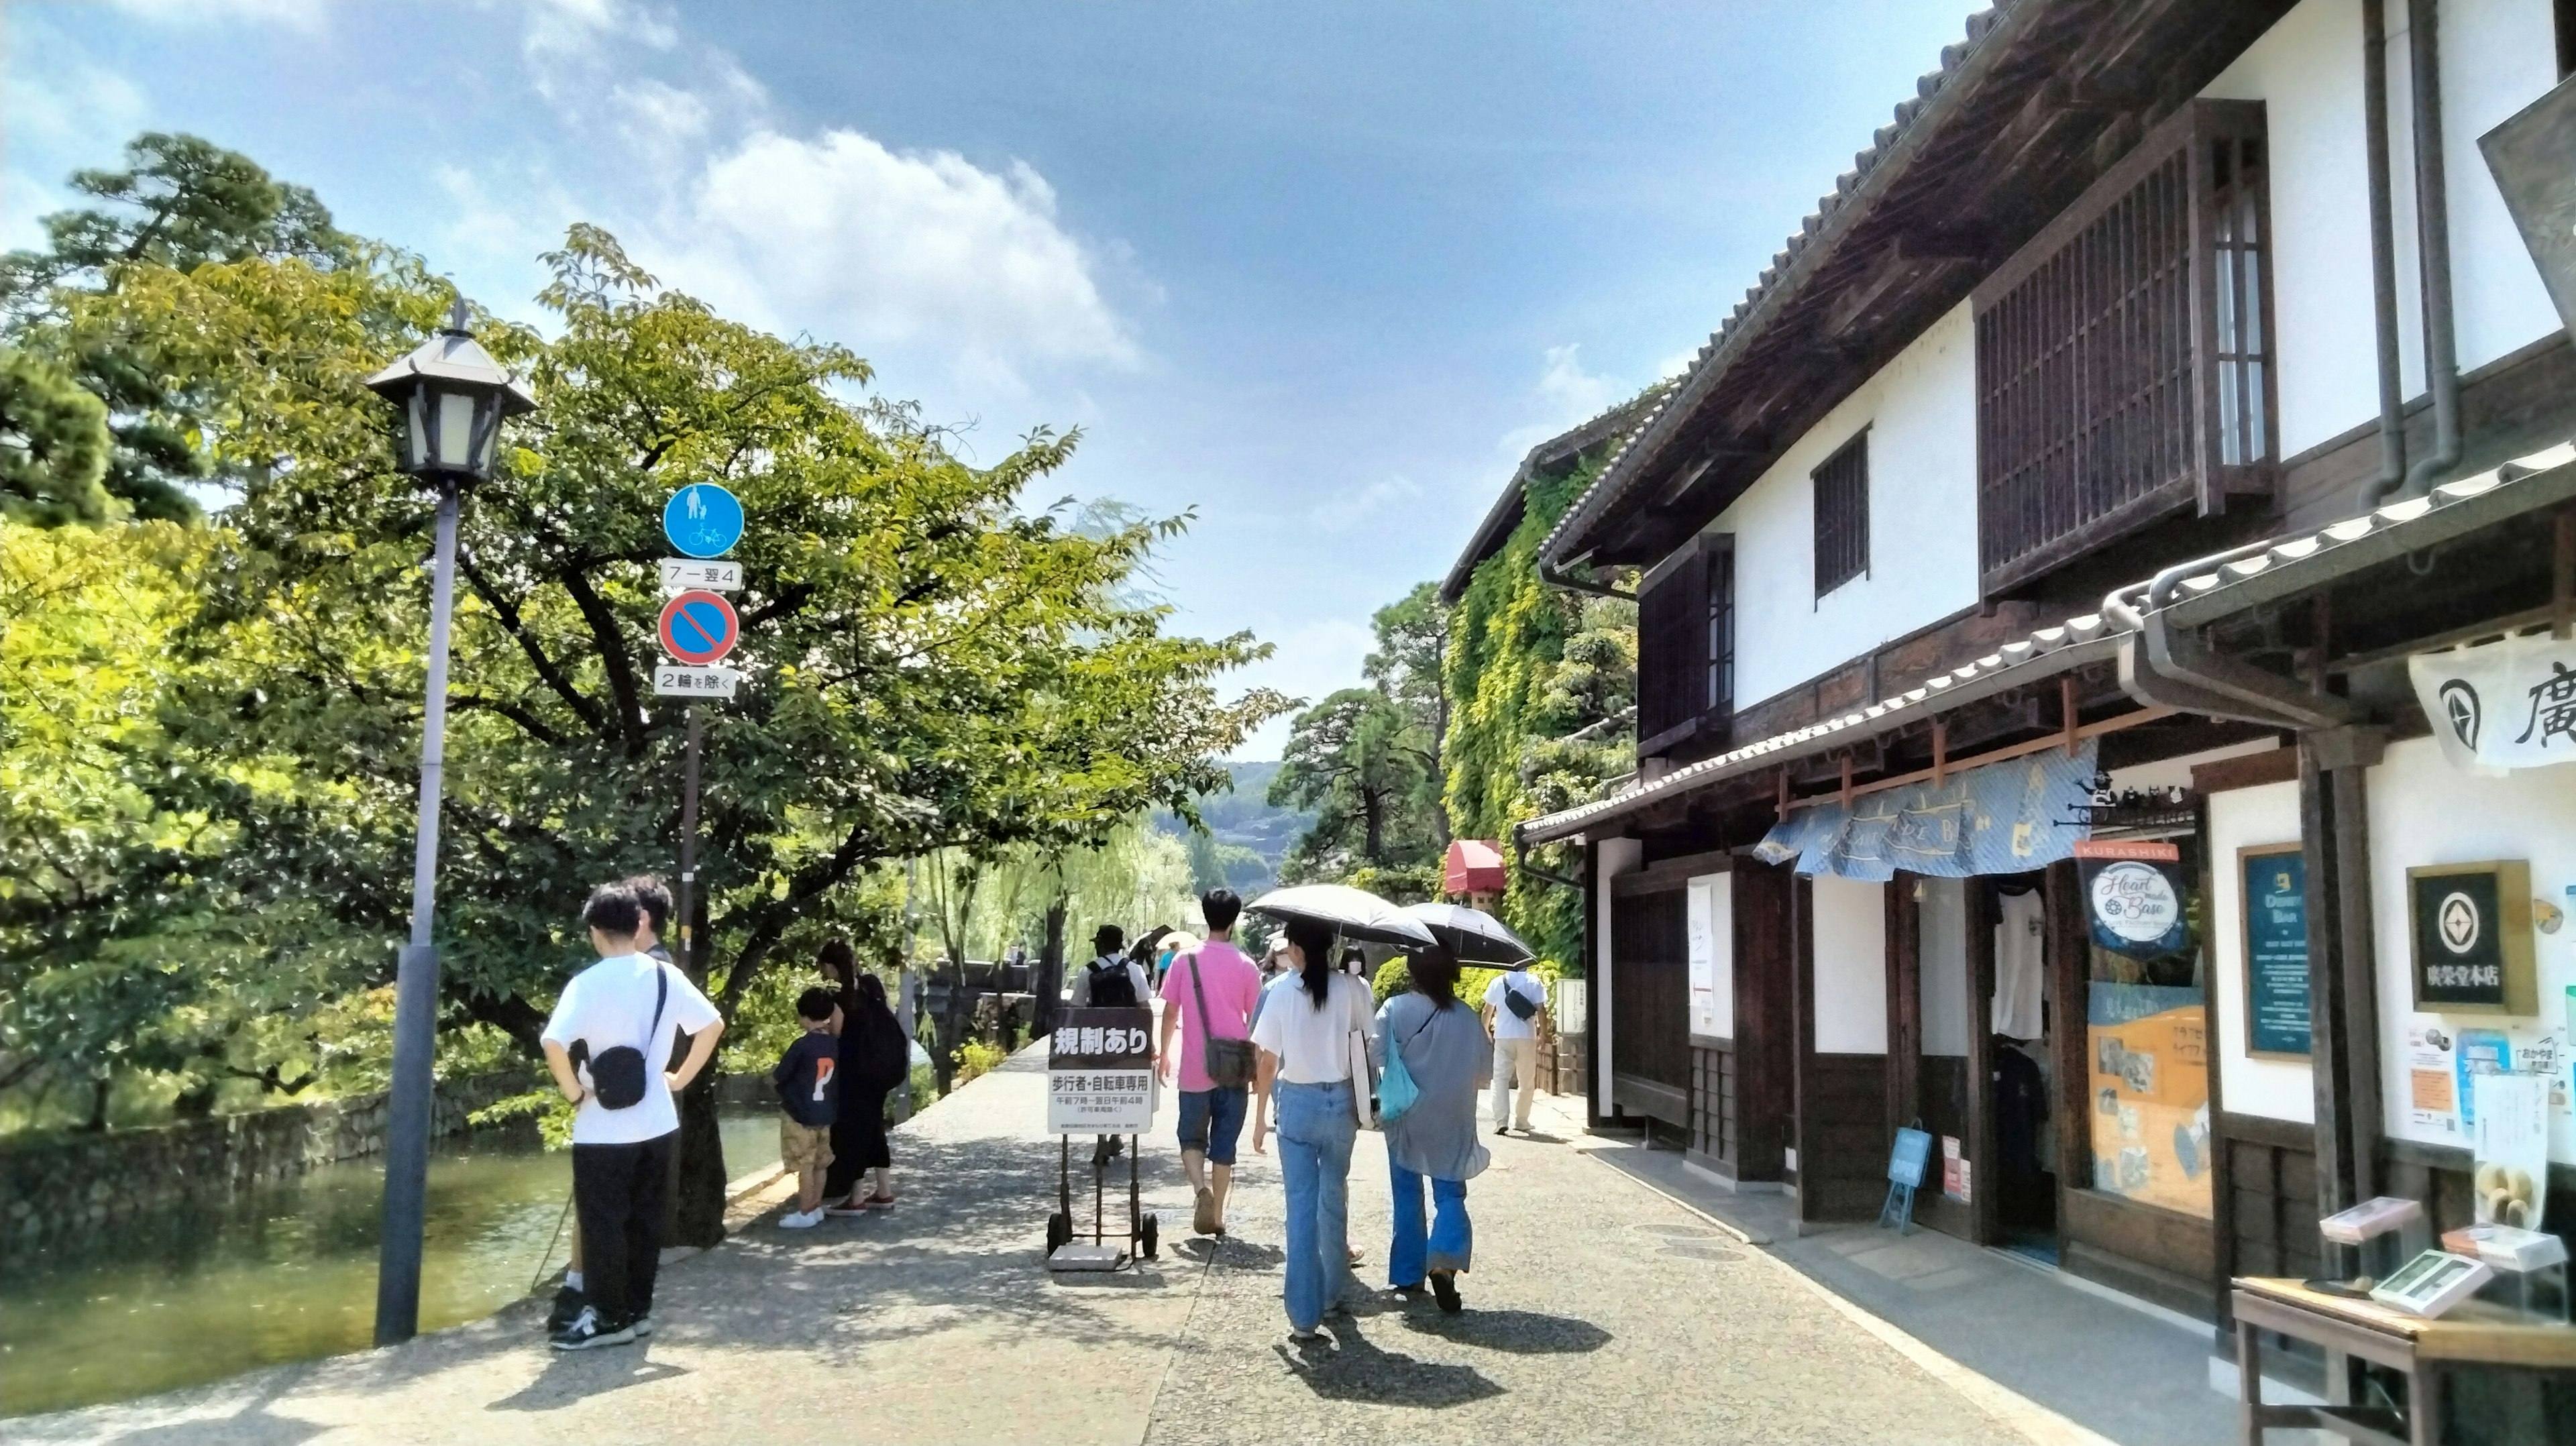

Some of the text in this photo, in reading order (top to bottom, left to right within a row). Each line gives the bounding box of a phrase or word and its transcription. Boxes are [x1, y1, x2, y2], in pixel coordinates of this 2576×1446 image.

[661, 673, 729, 690] 2輪を除く
[2082, 846, 2173, 858] KURASHIKI
[2098, 874, 2158, 895] Heart
[2113, 896, 2164, 920] Base
[1054, 1026, 1148, 1055] 規制あり
[1053, 1075, 1148, 1092] 歩行者・自転車専用
